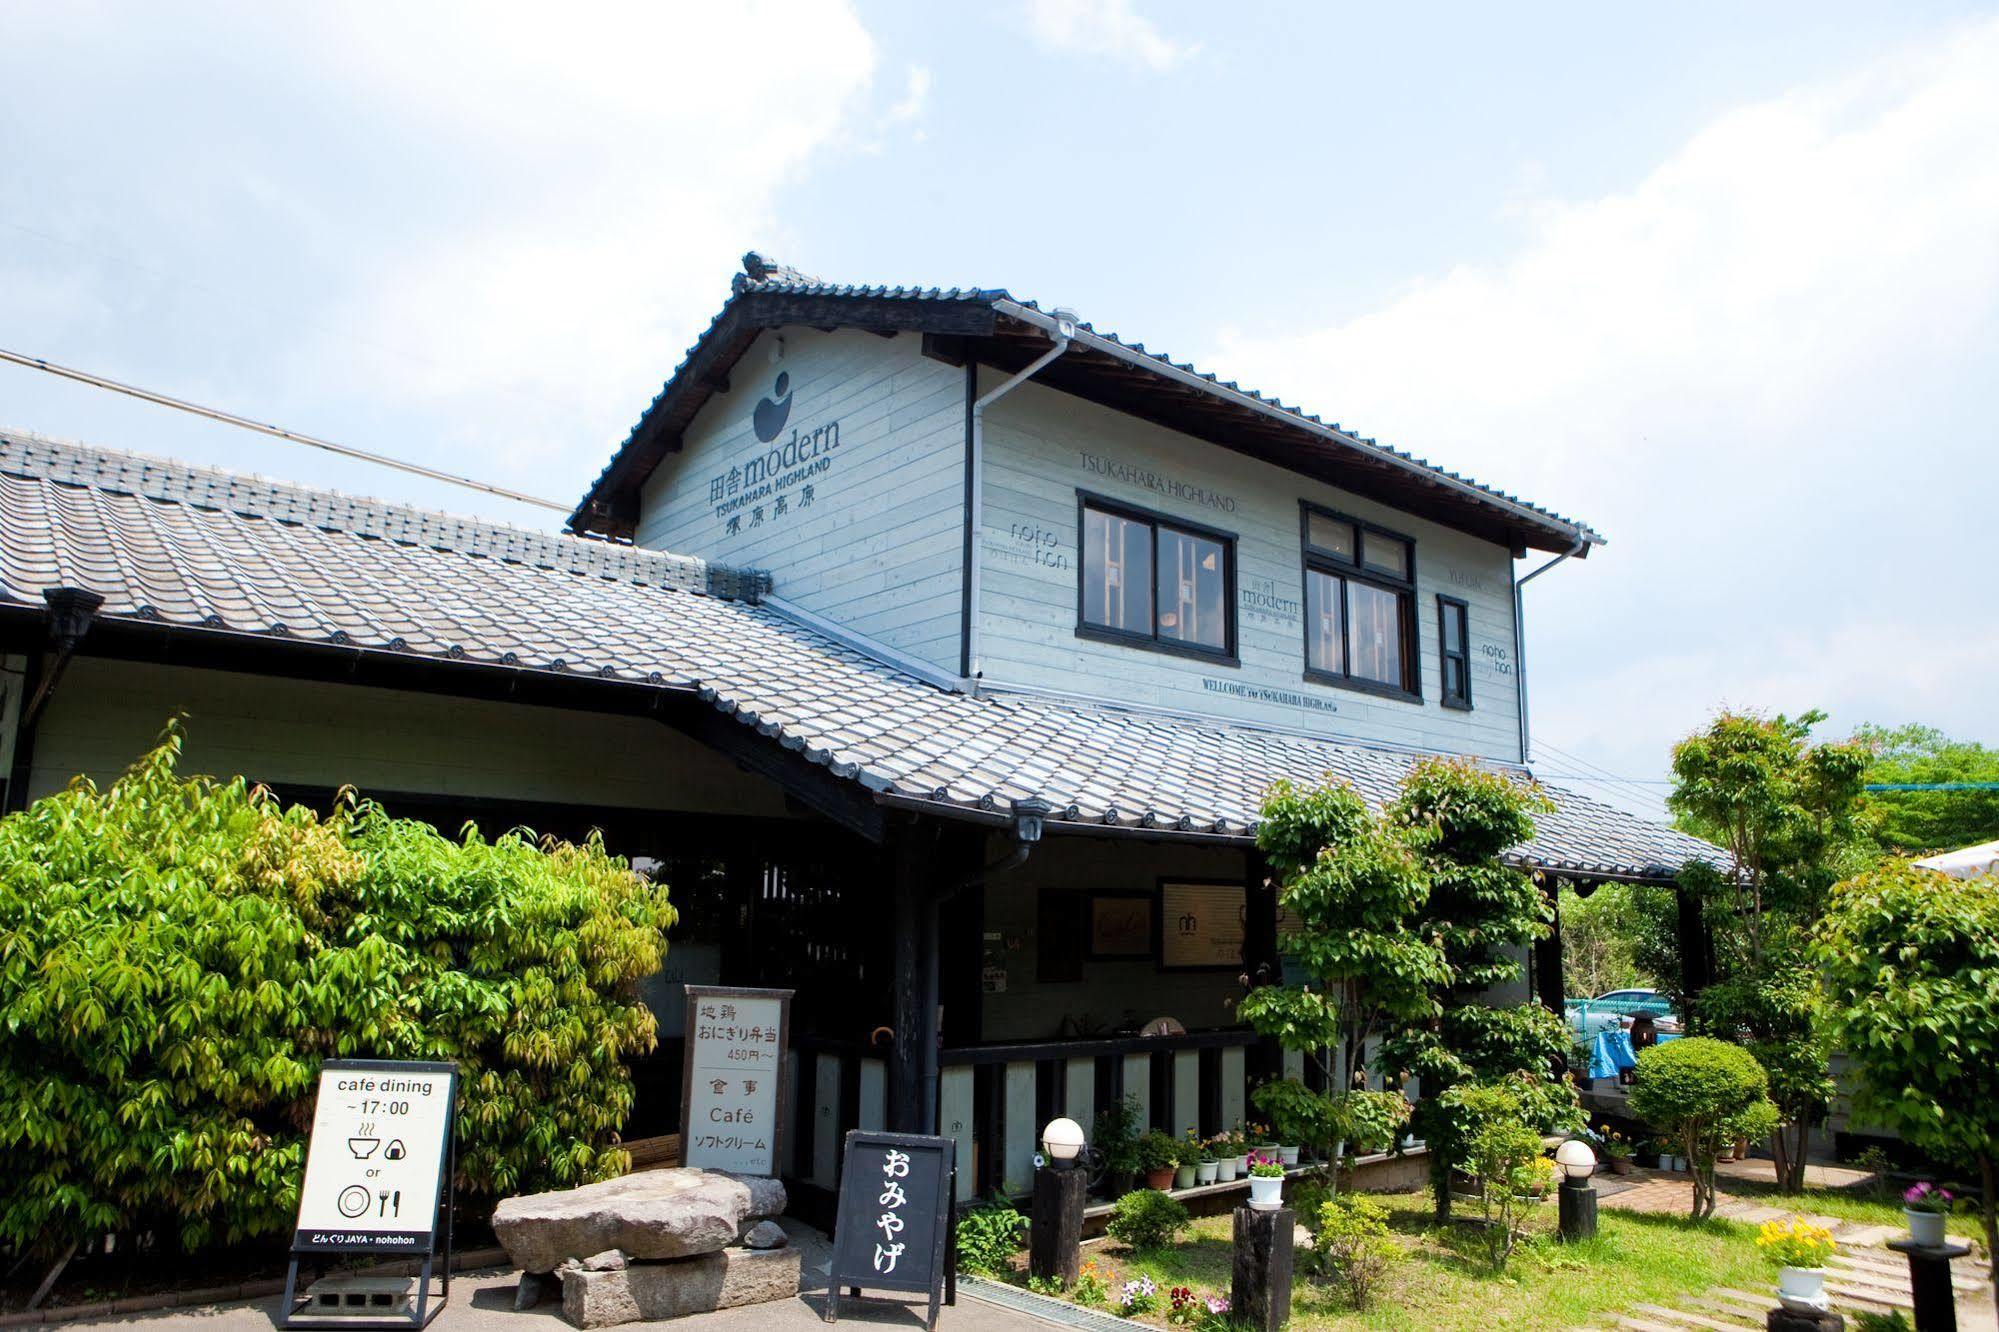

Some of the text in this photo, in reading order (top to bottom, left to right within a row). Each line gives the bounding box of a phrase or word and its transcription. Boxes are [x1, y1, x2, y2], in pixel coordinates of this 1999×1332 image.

[716, 457, 831, 518] TSUKAHARA HIGHLAND
[1080, 452, 1235, 512] TSUKAHARA HIGHLAND
[1243, 581, 1298, 614] modern
[700, 1005, 736, 1021] 地鶏
[698, 1026, 777, 1043] おにぎり弁当
[338, 1077, 433, 1096] café dining
[710, 1107, 754, 1124] Café
[695, 1135, 767, 1150] ソフトクリーム
[365, 1167, 381, 1178] or
[874, 1149, 911, 1274] おみやげ
